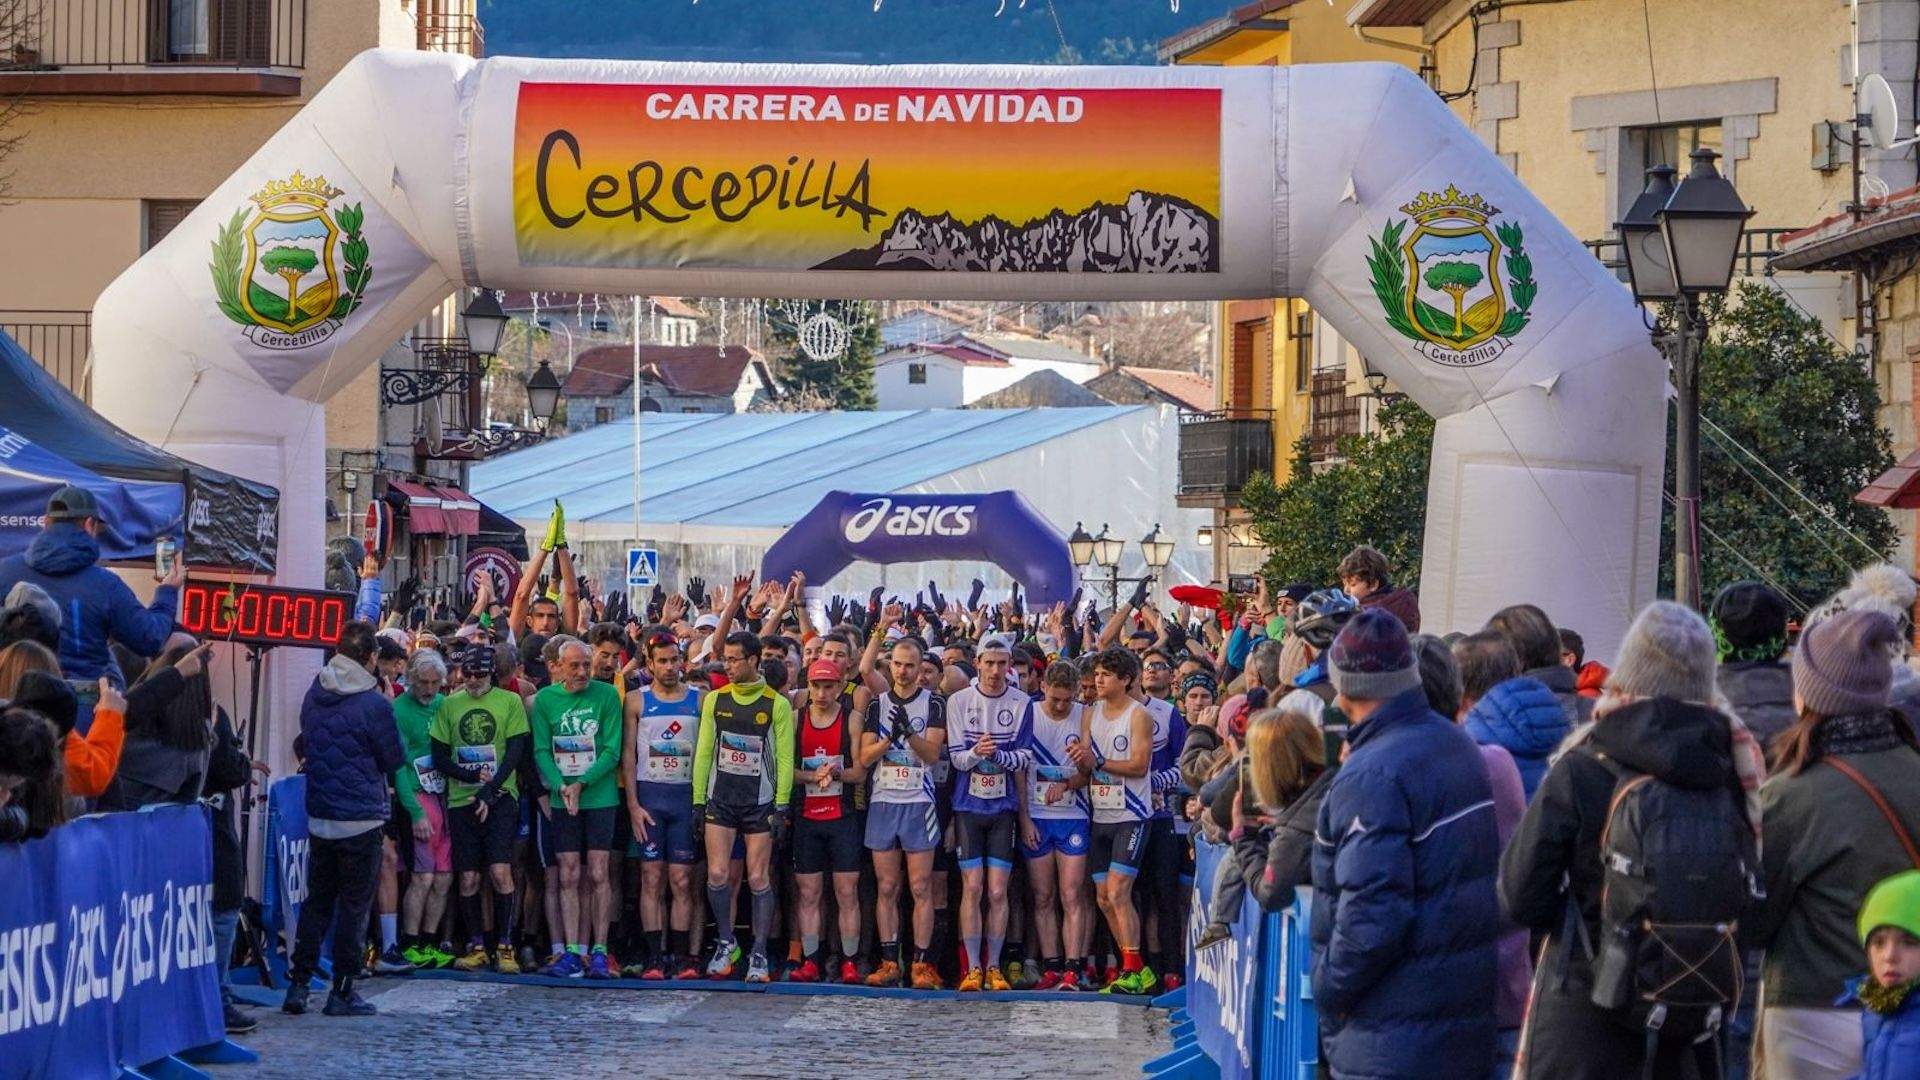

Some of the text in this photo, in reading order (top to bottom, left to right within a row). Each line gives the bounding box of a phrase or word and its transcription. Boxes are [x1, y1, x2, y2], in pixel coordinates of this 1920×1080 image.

[646, 93, 1084, 123] CARRERA DE NAVIDAD
[261, 326, 328, 347] Cercedilla
[1431, 344, 1497, 364] Cercedilla
[663, 757, 678, 768] 55
[731, 752, 747, 763] 69
[895, 768, 909, 778] 16
[981, 776, 996, 787] 96
